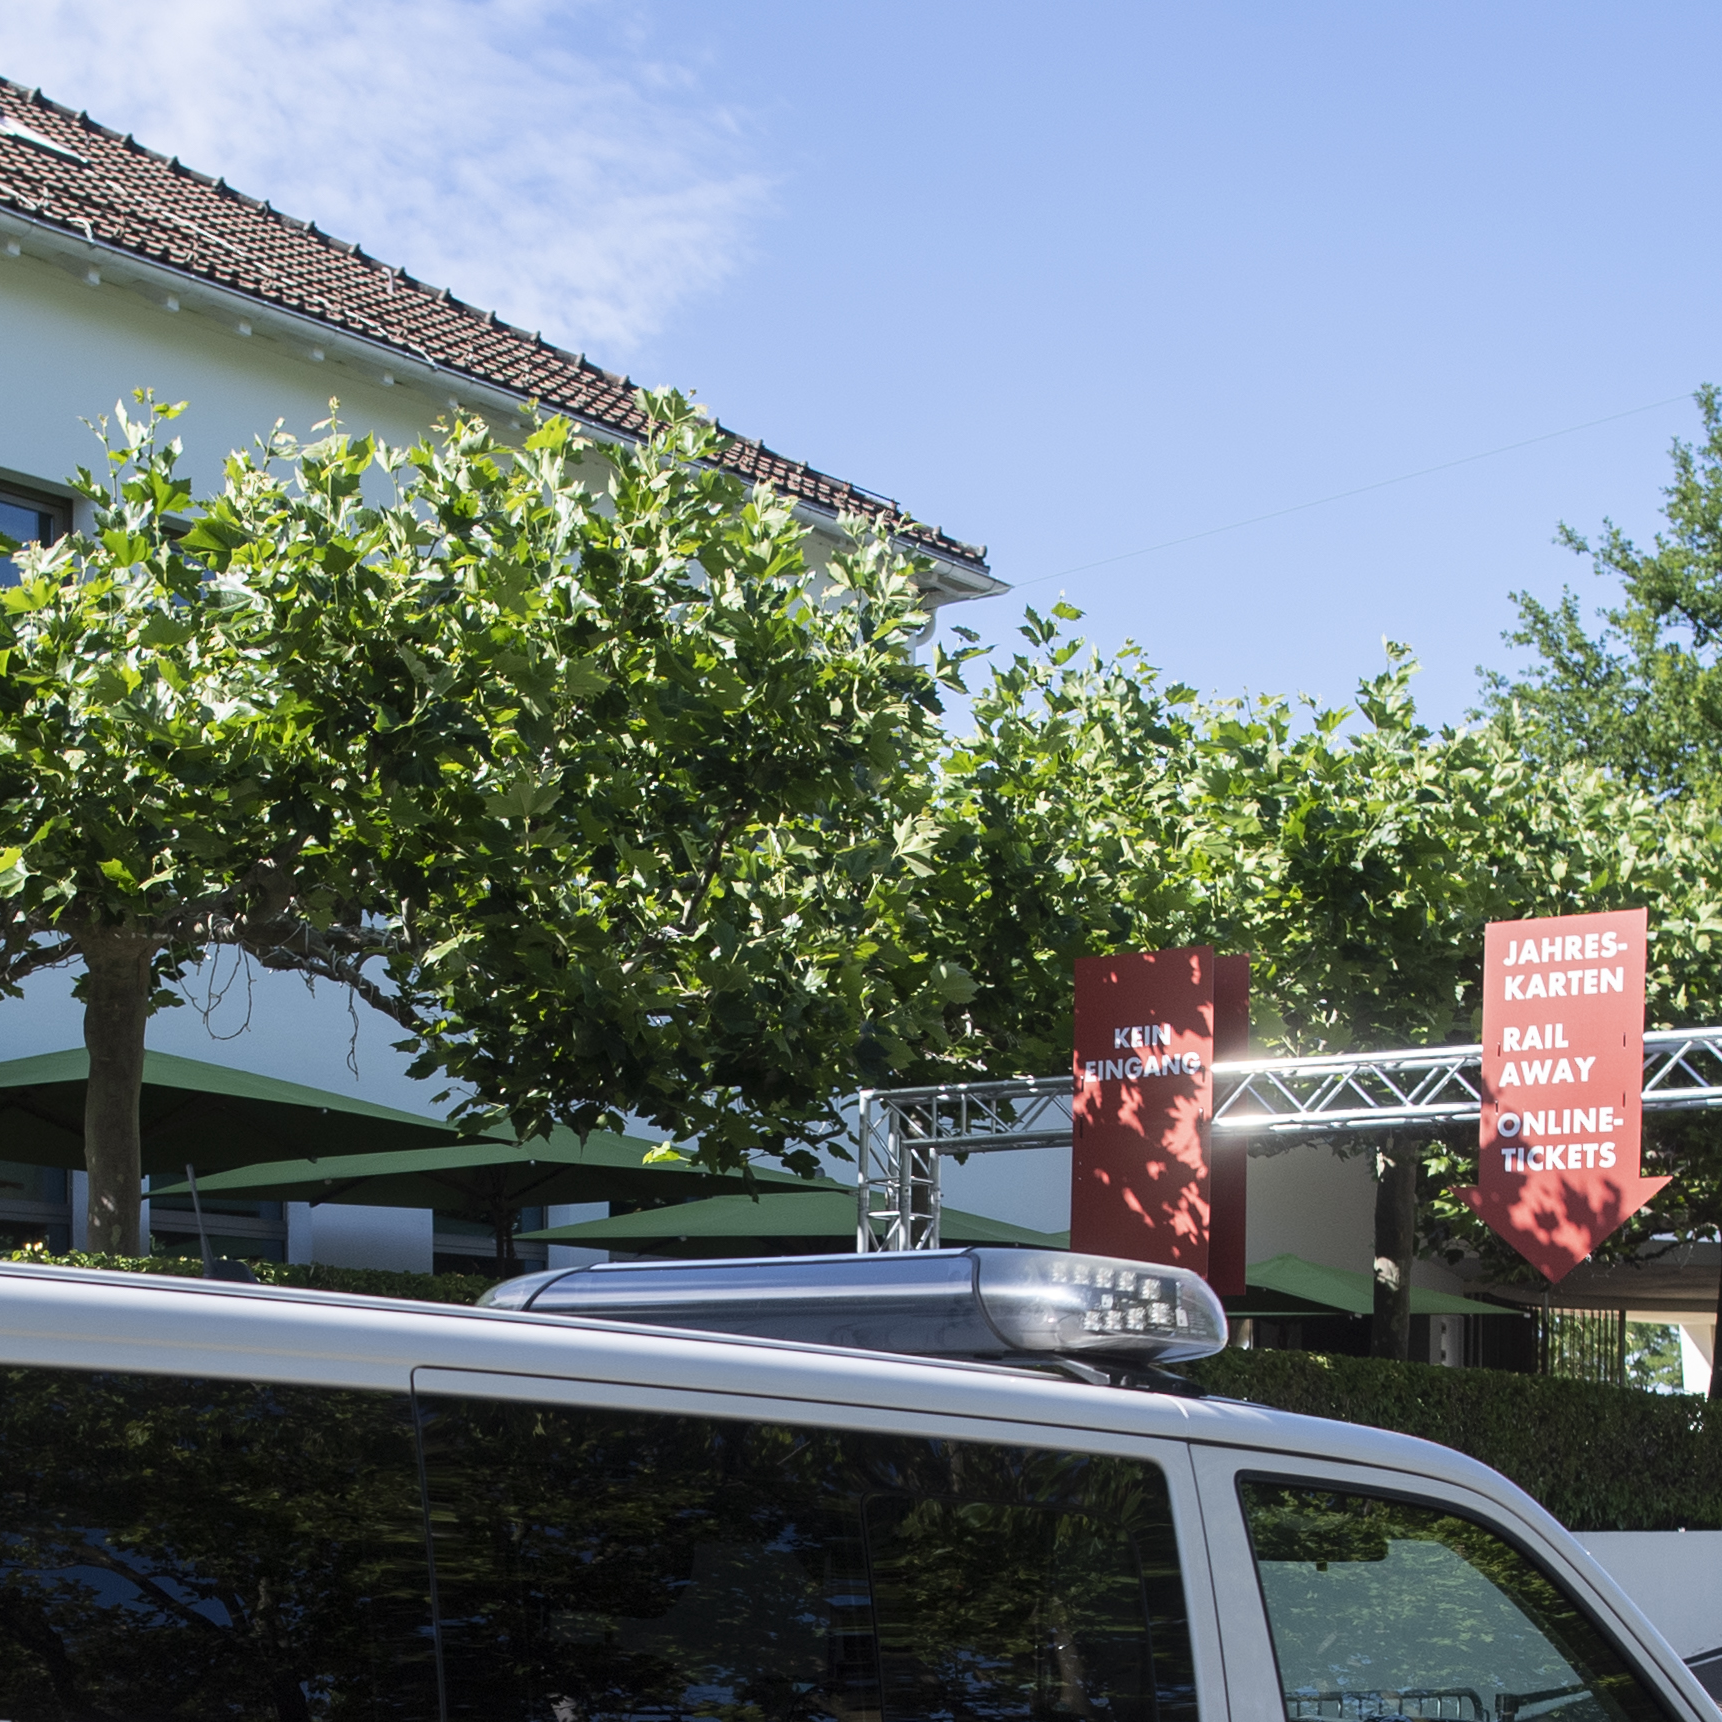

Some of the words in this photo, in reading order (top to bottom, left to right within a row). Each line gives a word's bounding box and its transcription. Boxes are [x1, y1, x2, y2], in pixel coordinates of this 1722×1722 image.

[1502, 931, 1628, 967] JAHRES-
[1504, 966, 1624, 1001] KARTEN
[1114, 1023, 1171, 1049] KEIN
[1503, 1023, 1569, 1052] RAIL
[1084, 1051, 1202, 1083] EINGANG
[1498, 1056, 1596, 1088] AWAY
[1497, 1106, 1624, 1138] ONLINE-
[1501, 1141, 1617, 1172] TICKETS
